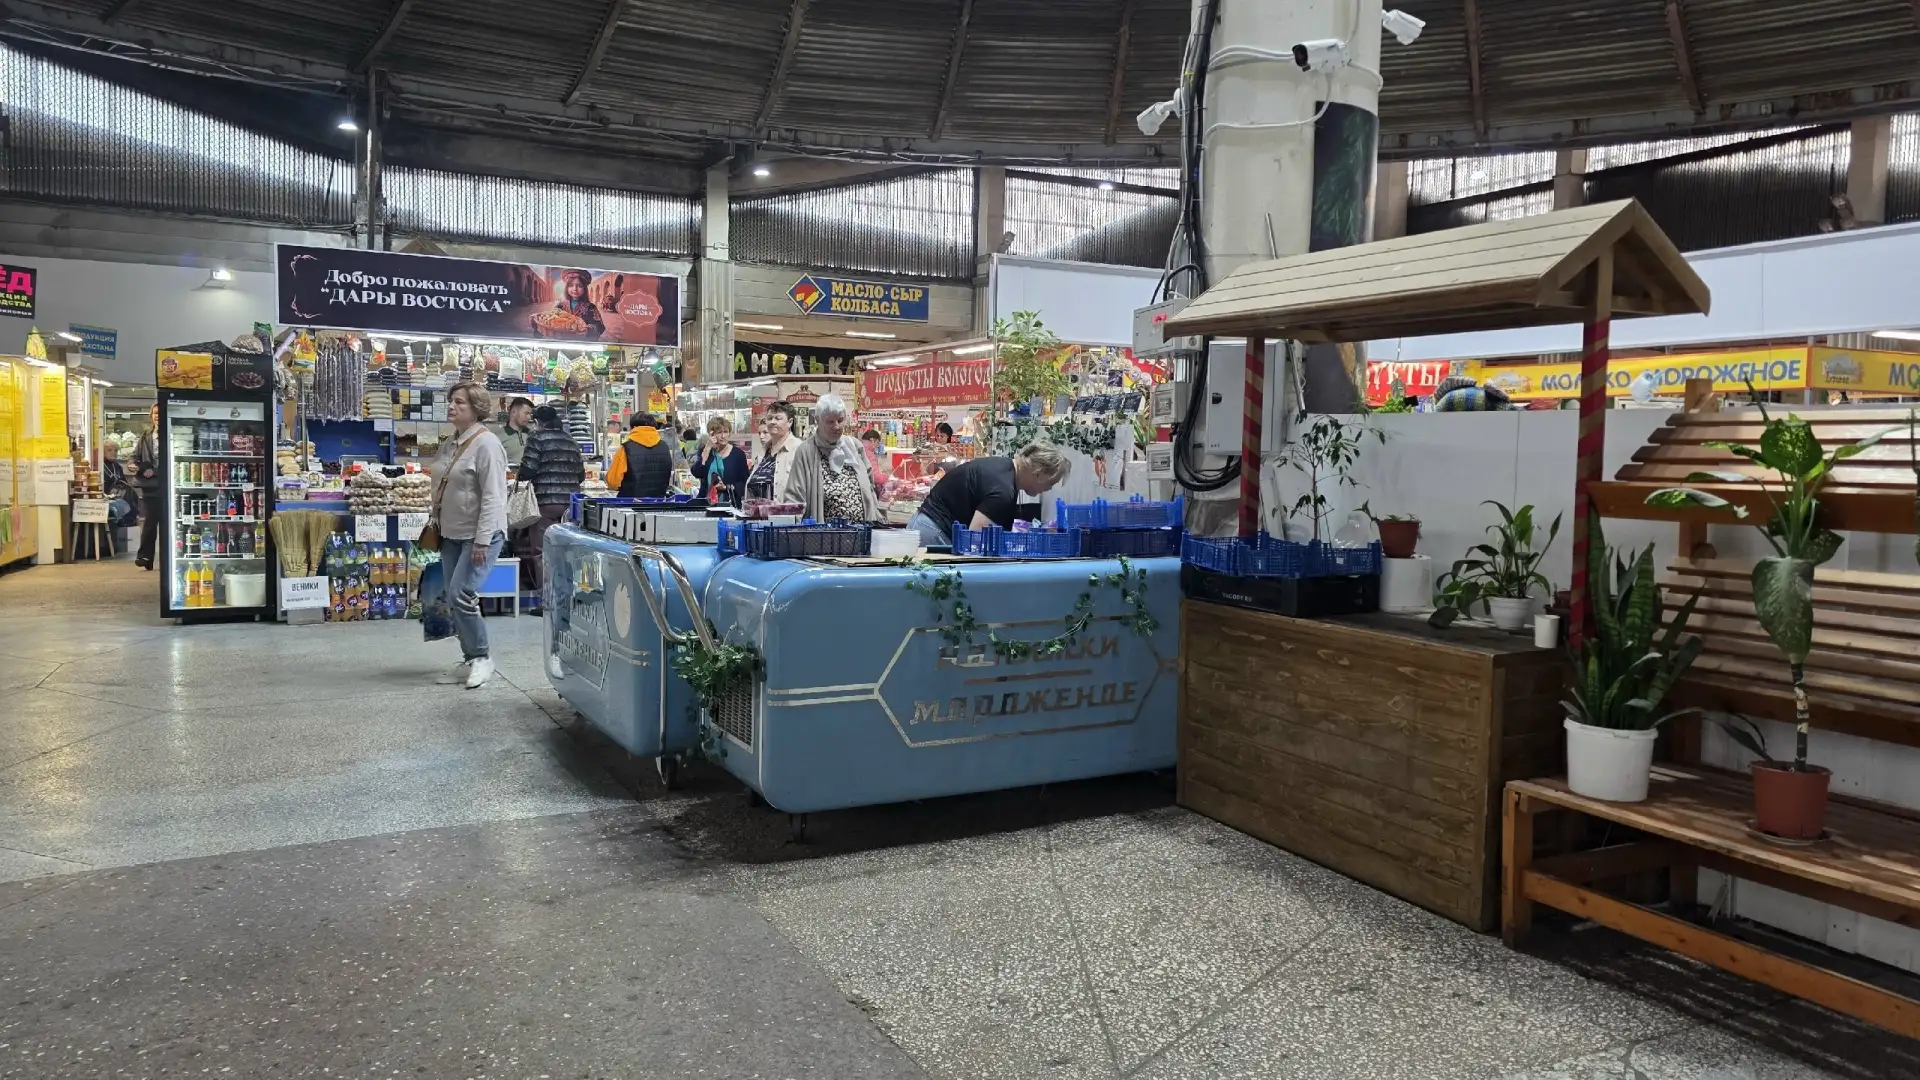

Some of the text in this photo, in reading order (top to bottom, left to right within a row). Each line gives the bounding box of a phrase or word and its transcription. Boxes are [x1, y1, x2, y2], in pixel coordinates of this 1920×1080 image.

[324, 269, 508, 295] Добро пожаловать
[831, 281, 923, 302] МАСЛО СЫР
[831, 297, 900, 316] КОЛБАСА
[875, 367, 933, 395] ПРОДУКТЫ
[1541, 370, 1631, 391] МОКО
[292, 582, 318, 591] ВЕНИКИ
